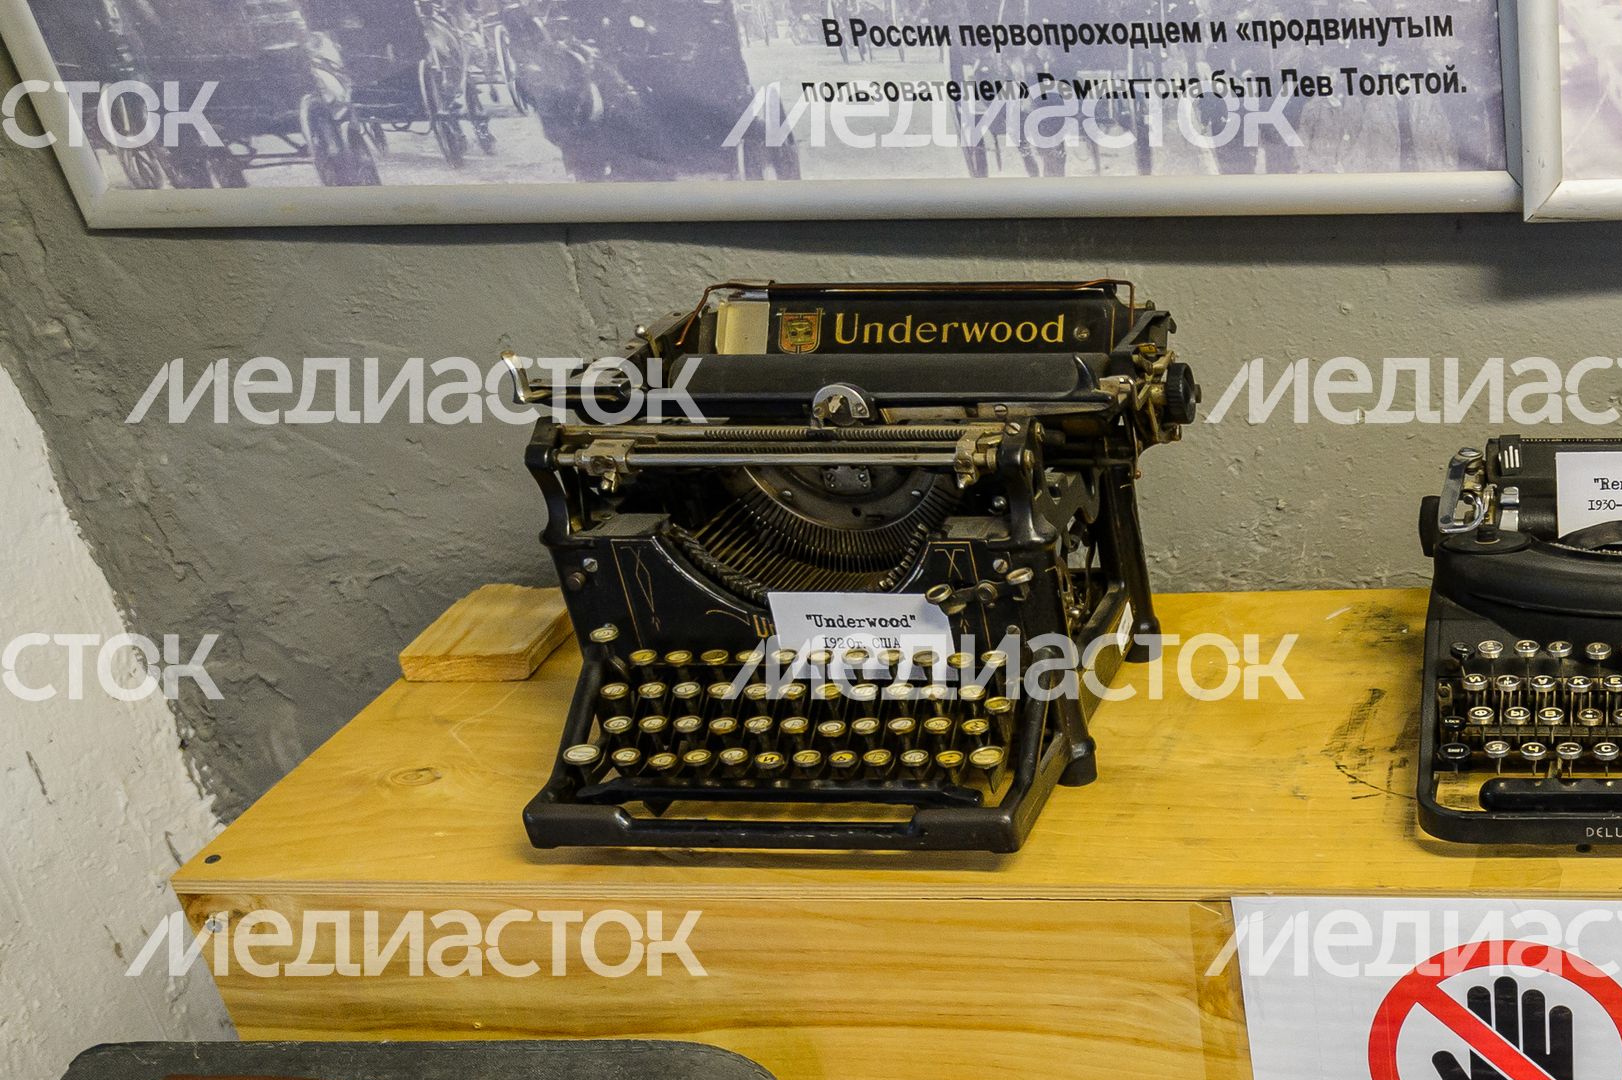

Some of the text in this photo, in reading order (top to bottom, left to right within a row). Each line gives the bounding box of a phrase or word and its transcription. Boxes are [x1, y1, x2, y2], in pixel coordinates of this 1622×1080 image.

[821, 14, 1454, 53] В России первопроходцем и «продвинутым
[801, 65, 1467, 103] пользователем» Ремингтона был Лев Толстой.
[834, 312, 1066, 346] Underwood
[805, 613, 917, 629] "Underwood"
